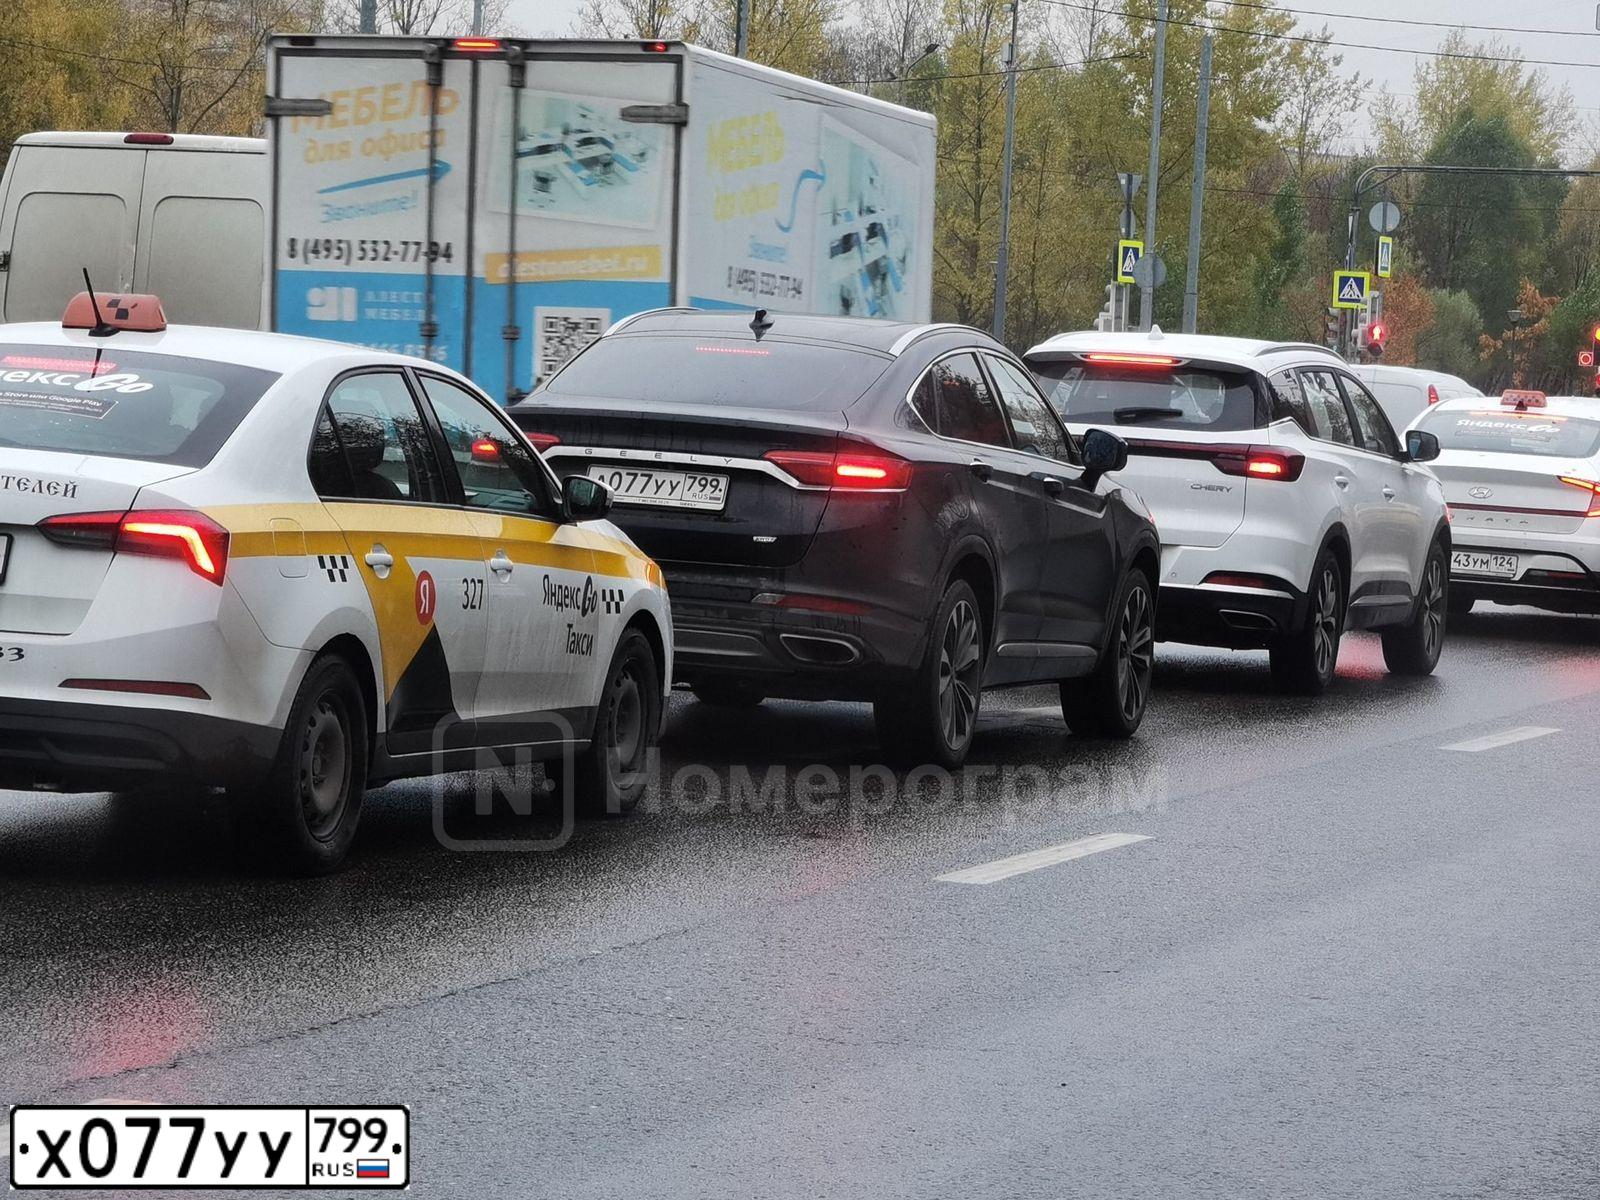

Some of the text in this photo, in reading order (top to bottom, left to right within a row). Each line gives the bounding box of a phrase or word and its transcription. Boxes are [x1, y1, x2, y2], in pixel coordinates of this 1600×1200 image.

[288, 237, 298, 259] 8
[302, 238, 352, 266] (495)
[49, 395, 82, 404] Google
[82, 399, 103, 407] Play
[584, 448, 733, 465] GEELY
[686, 475, 721, 494] 799
[1190, 483, 1233, 493] CHERY
[691, 492, 709, 500] RUS
[1492, 556, 1513, 568] 124
[461, 578, 484, 610] 327
[542, 574, 581, 612] Яндекс
[566, 623, 594, 657] Такси
